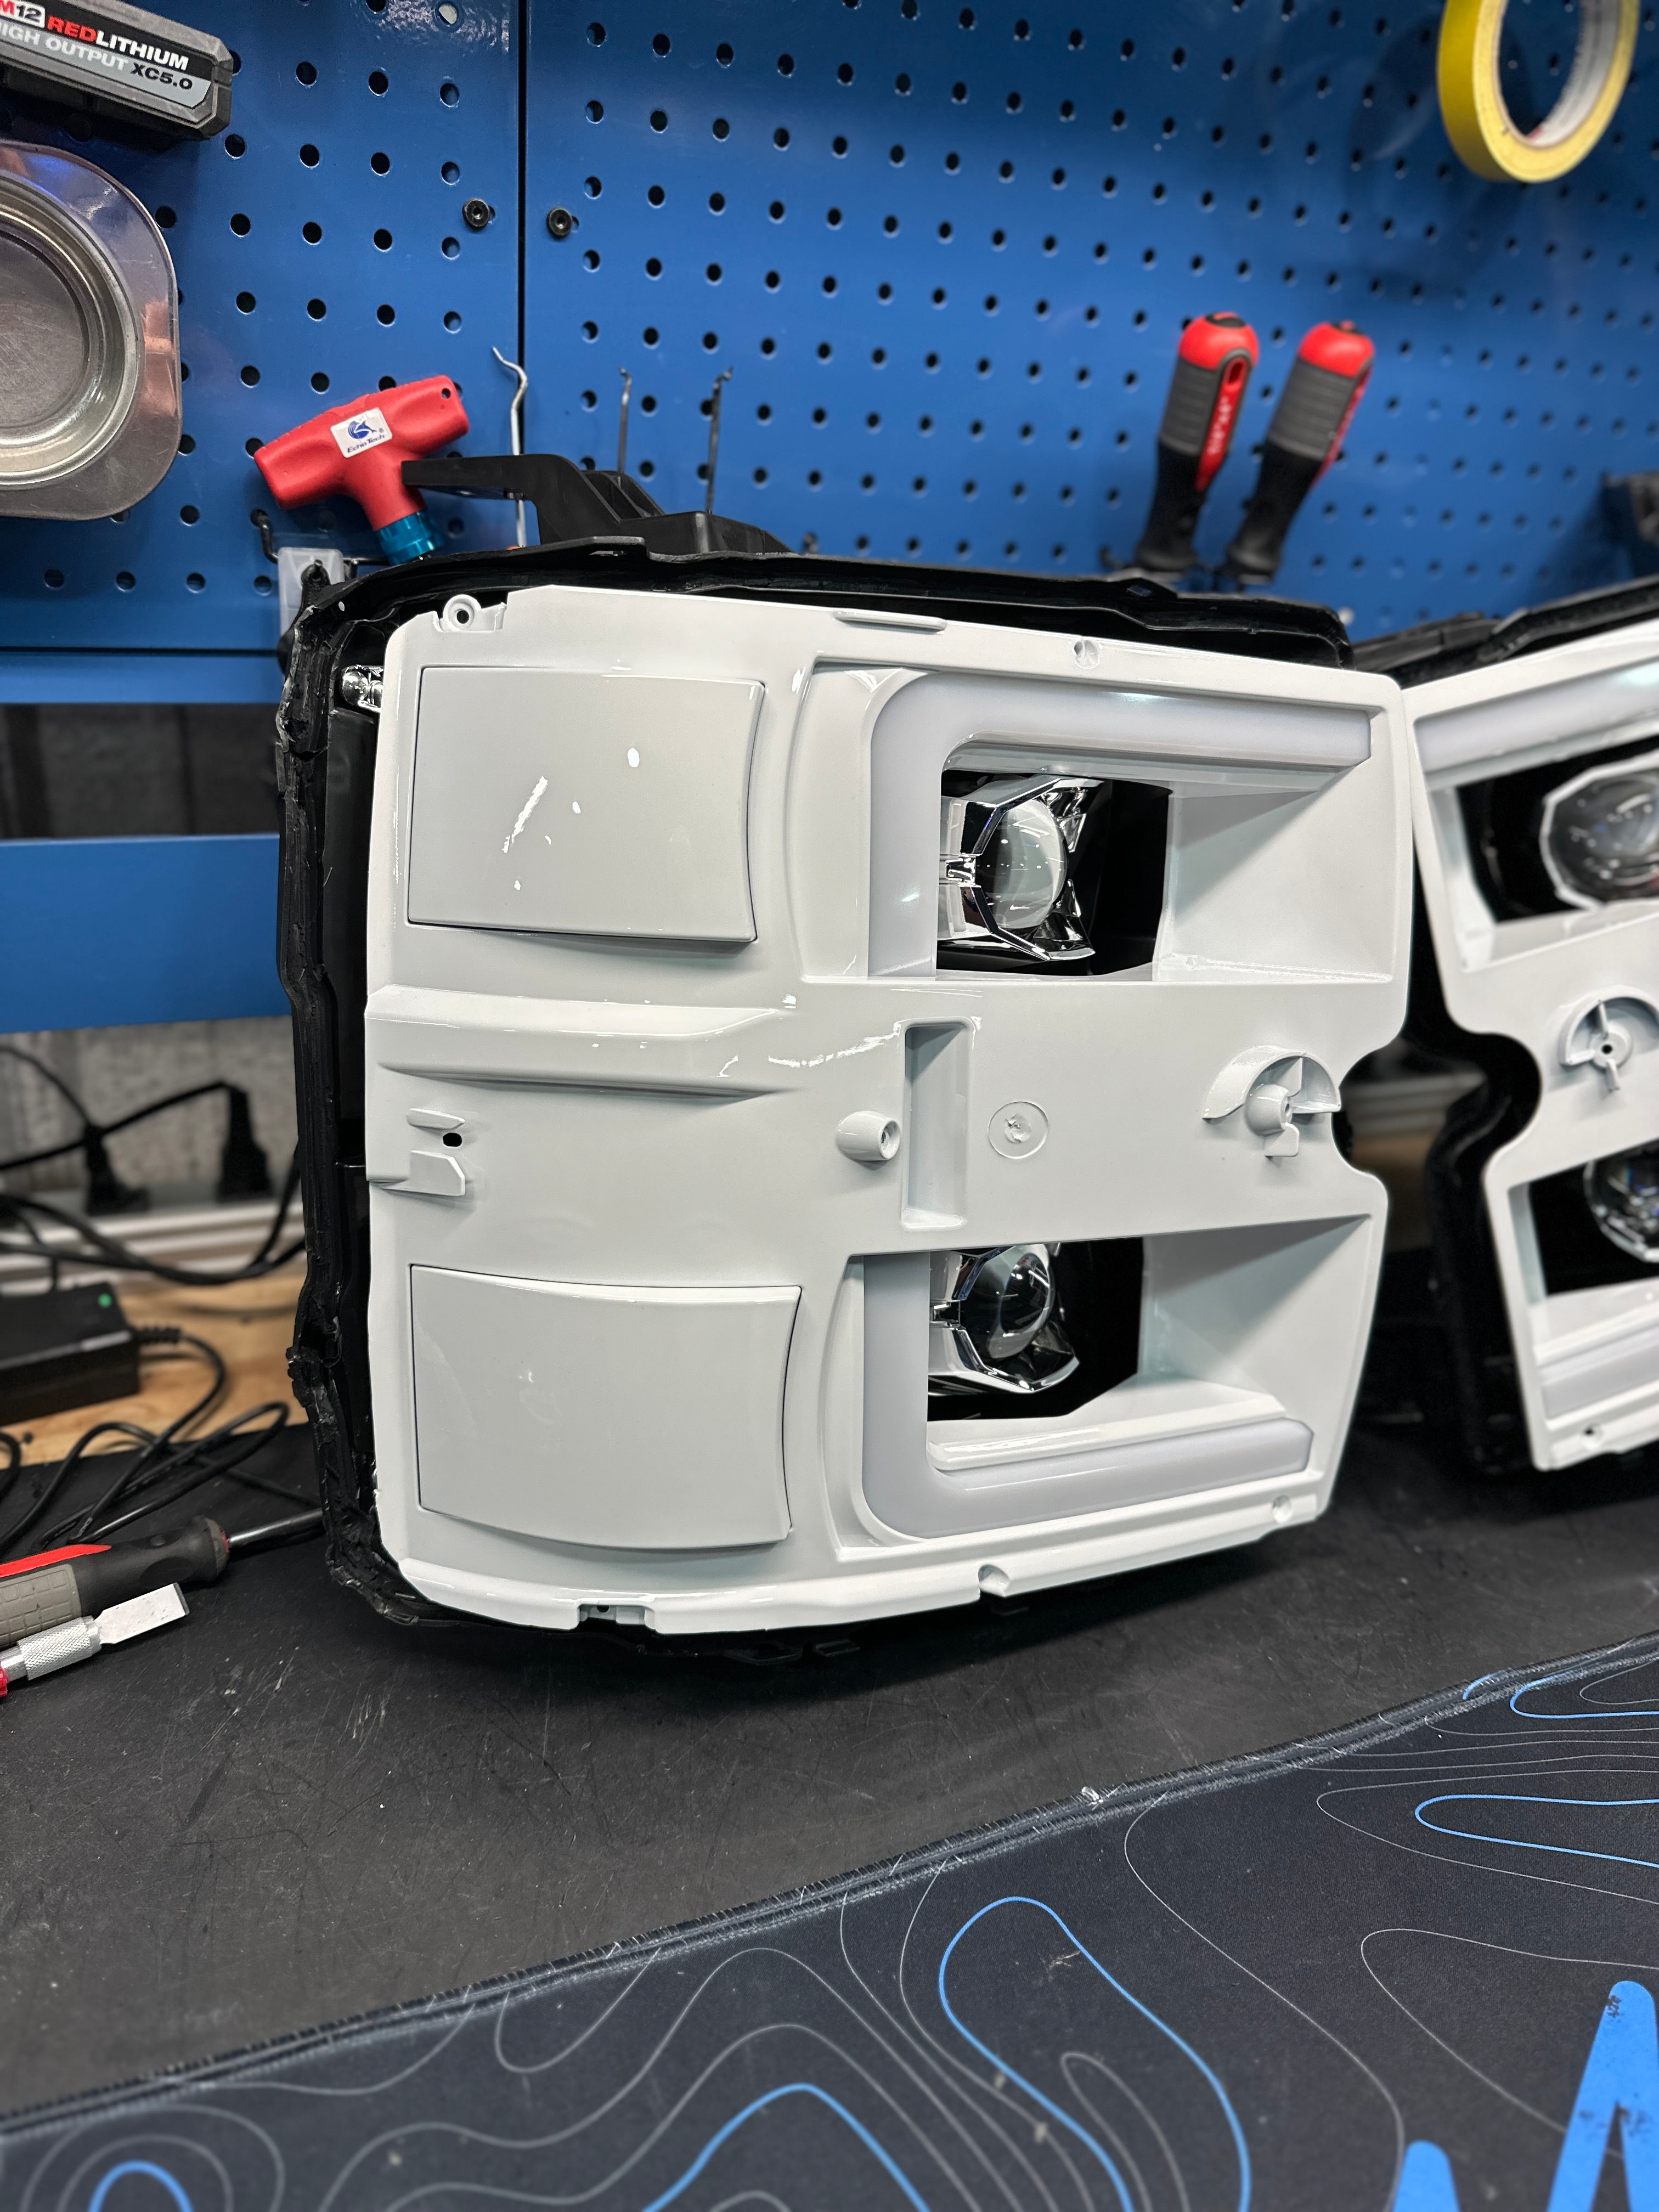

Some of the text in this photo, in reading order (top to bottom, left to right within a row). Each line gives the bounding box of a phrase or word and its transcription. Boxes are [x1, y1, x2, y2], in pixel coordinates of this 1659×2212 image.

[0, 0, 189, 71] M12 REDLITHIUM
[0, 22, 193, 90] IGH OUTPUT XC5.0
